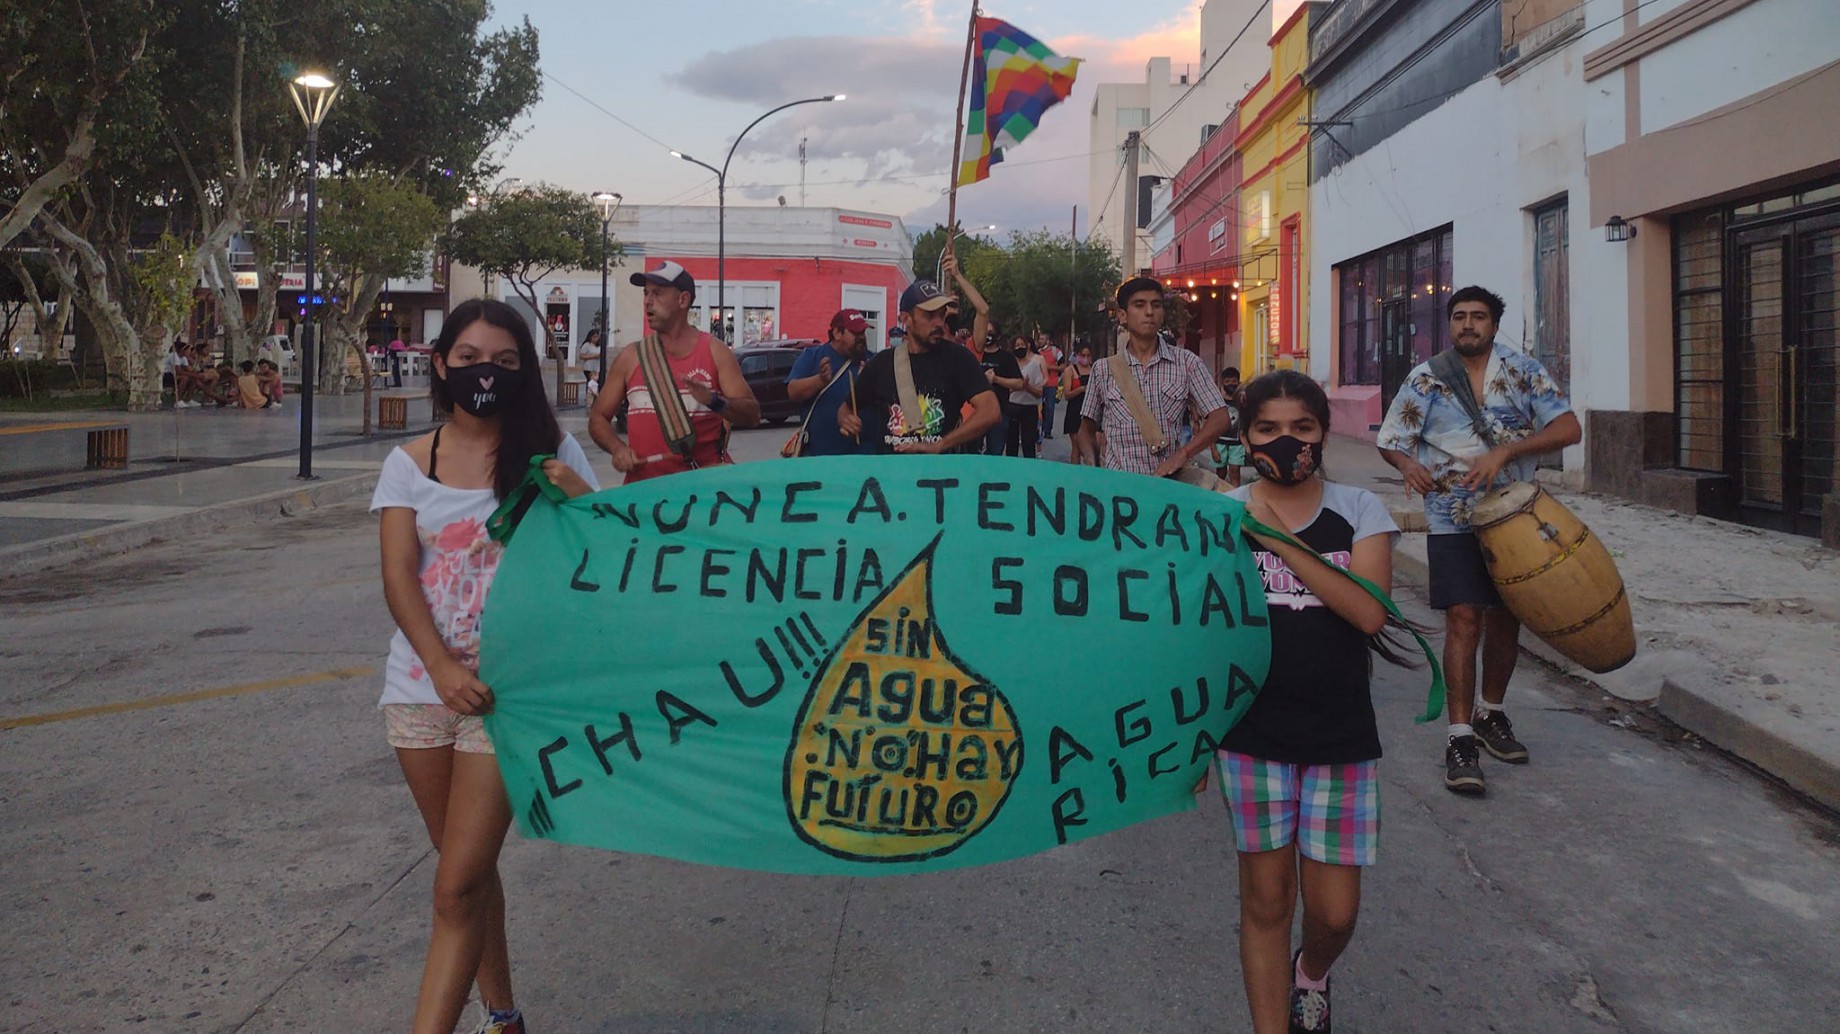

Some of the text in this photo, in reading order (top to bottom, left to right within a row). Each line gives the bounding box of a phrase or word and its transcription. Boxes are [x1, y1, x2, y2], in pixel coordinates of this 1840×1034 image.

[917, 479, 1235, 557] TENDRAN
[1049, 663, 1259, 784] AGUA
[800, 770, 978, 828] FUTURO
